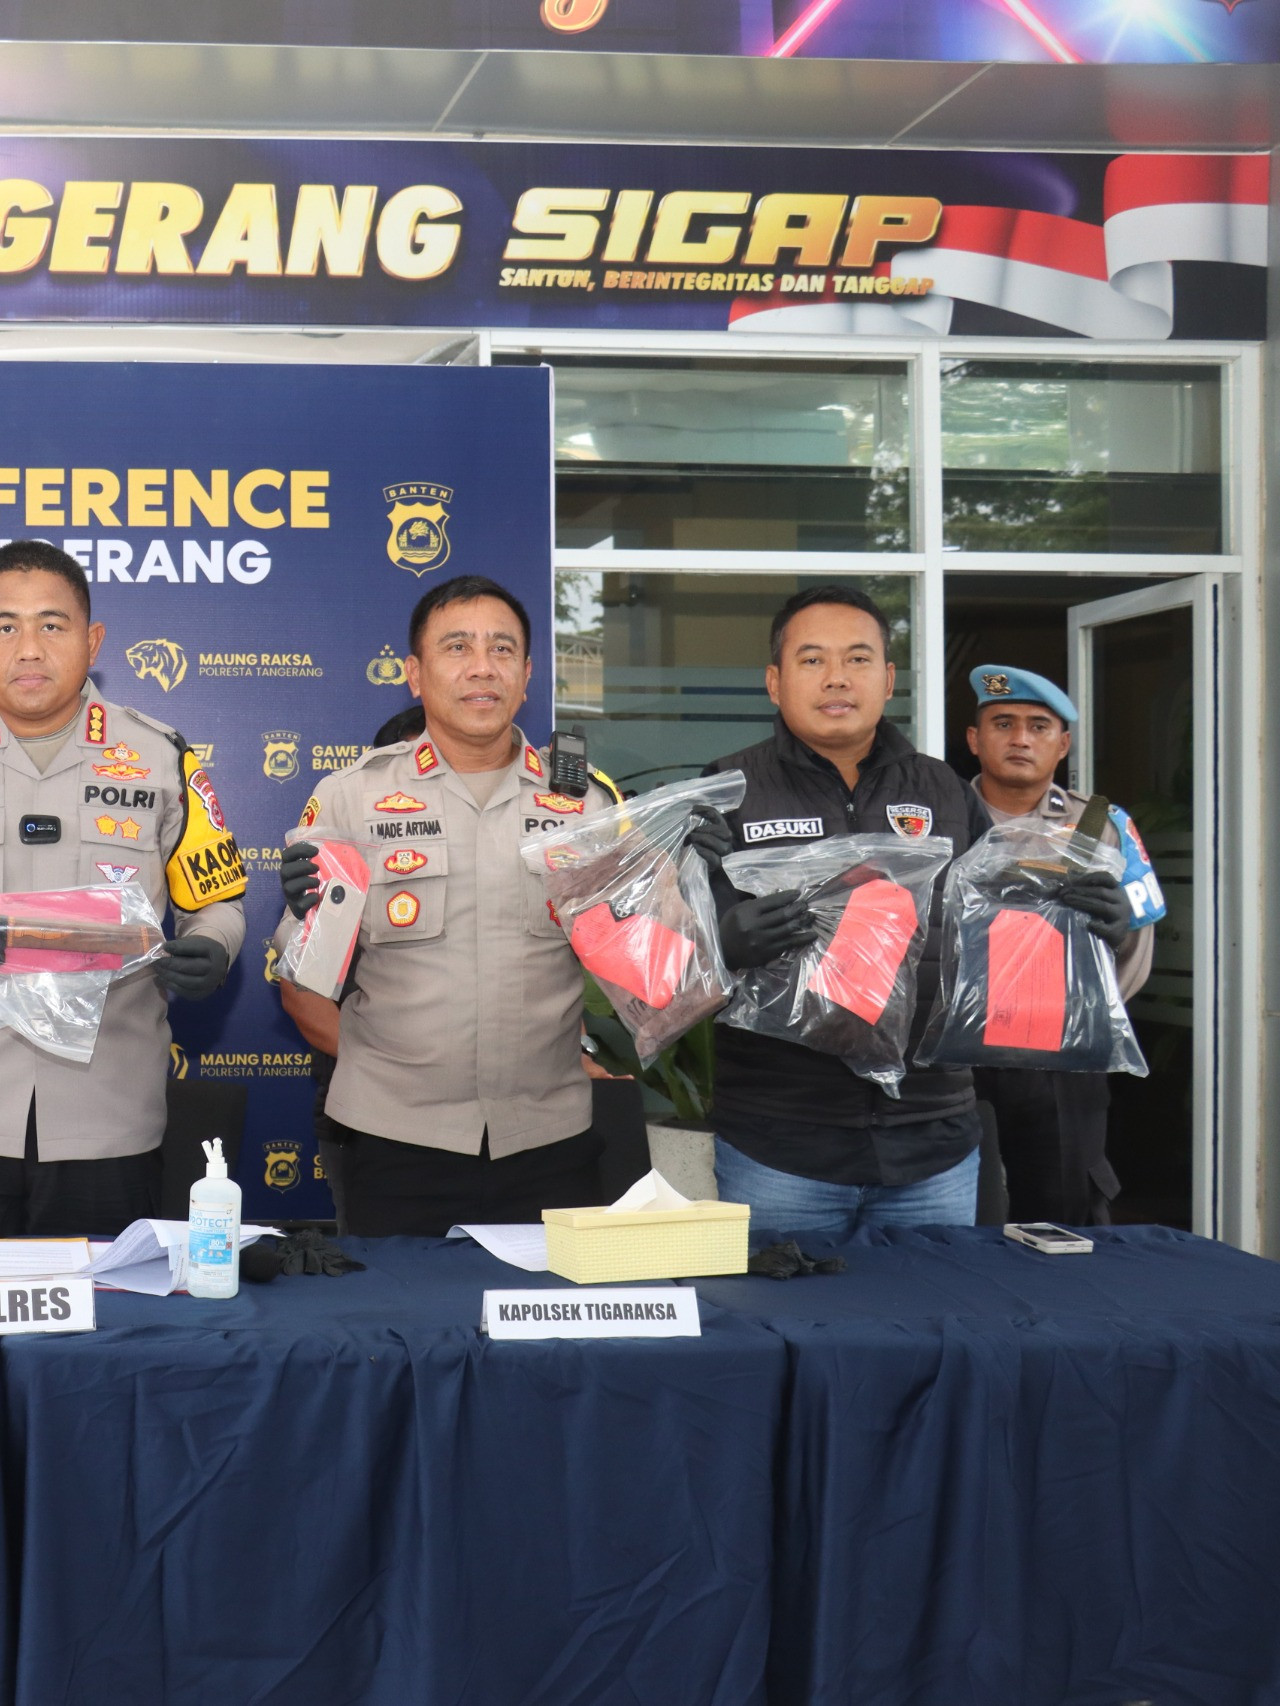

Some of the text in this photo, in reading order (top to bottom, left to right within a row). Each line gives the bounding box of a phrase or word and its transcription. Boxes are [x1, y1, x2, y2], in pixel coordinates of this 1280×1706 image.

[502, 187, 943, 268] SIGAP
[499, 268, 934, 296] SANTUN, BERINTEGRITAS DAN TANGGAP
[387, 486, 449, 500] BANTEN
[199, 653, 313, 666] MAUNG RAKSA
[198, 667, 323, 678] POLRESTA TANGERANG
[312, 745, 359, 757] GAWE
[84, 785, 156, 809] POLRI
[376, 822, 404, 840] MADE
[405, 820, 442, 838] ARTANA
[750, 820, 818, 838] DASUKI
[198, 876, 220, 895] OPS
[200, 1053, 312, 1066] MAUNG RAKSA
[200, 1067, 254, 1077] POLRESTA
[498, 1302, 678, 1322] KAPOLSEK TIGARAKSA
